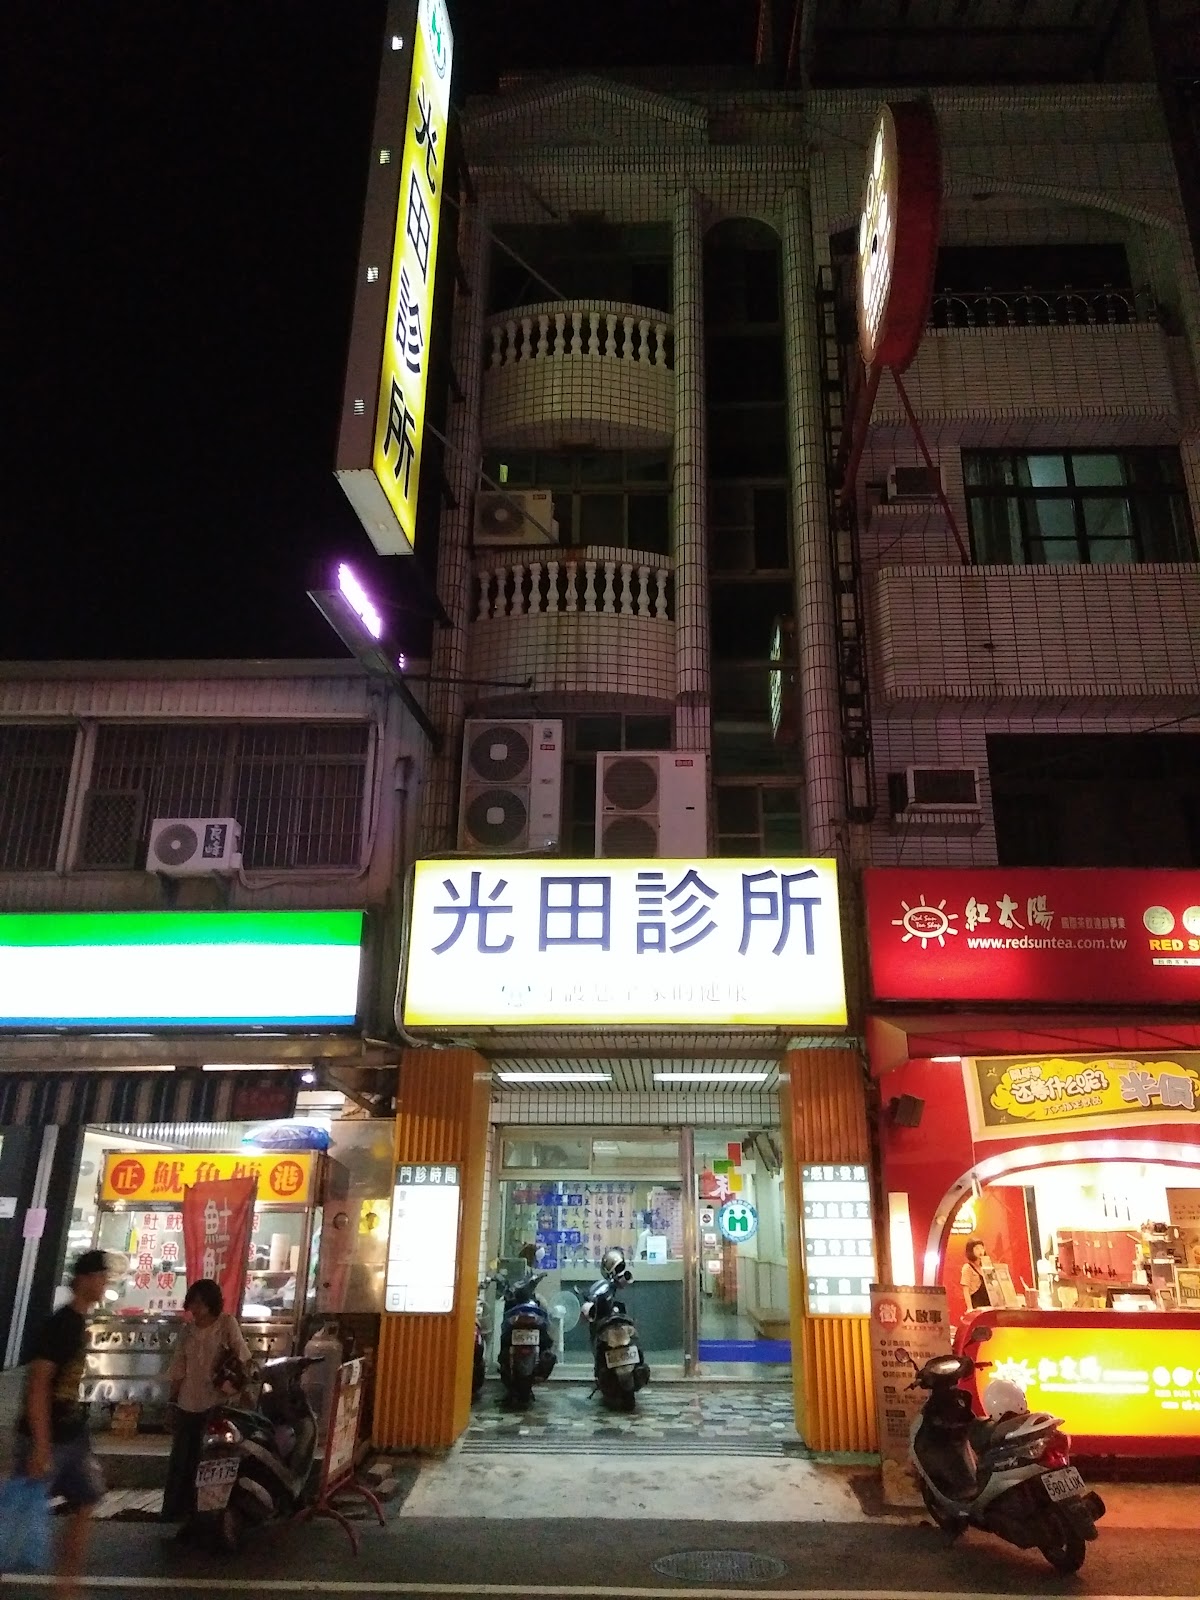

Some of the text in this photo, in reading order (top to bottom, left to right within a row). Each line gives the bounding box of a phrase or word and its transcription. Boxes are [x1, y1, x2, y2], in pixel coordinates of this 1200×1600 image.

[383, 82, 438, 500] 光田診所
[431, 868, 823, 956] 光田診所
[964, 894, 1054, 932] 紅太陽
[967, 935, 1128, 950] www.redsuntea.com.tw
[1149, 939, 1184, 951] RED
[117, 1164, 140, 1190] 正
[273, 1165, 300, 1192] 港
[399, 1166, 457, 1184] 門診時間
